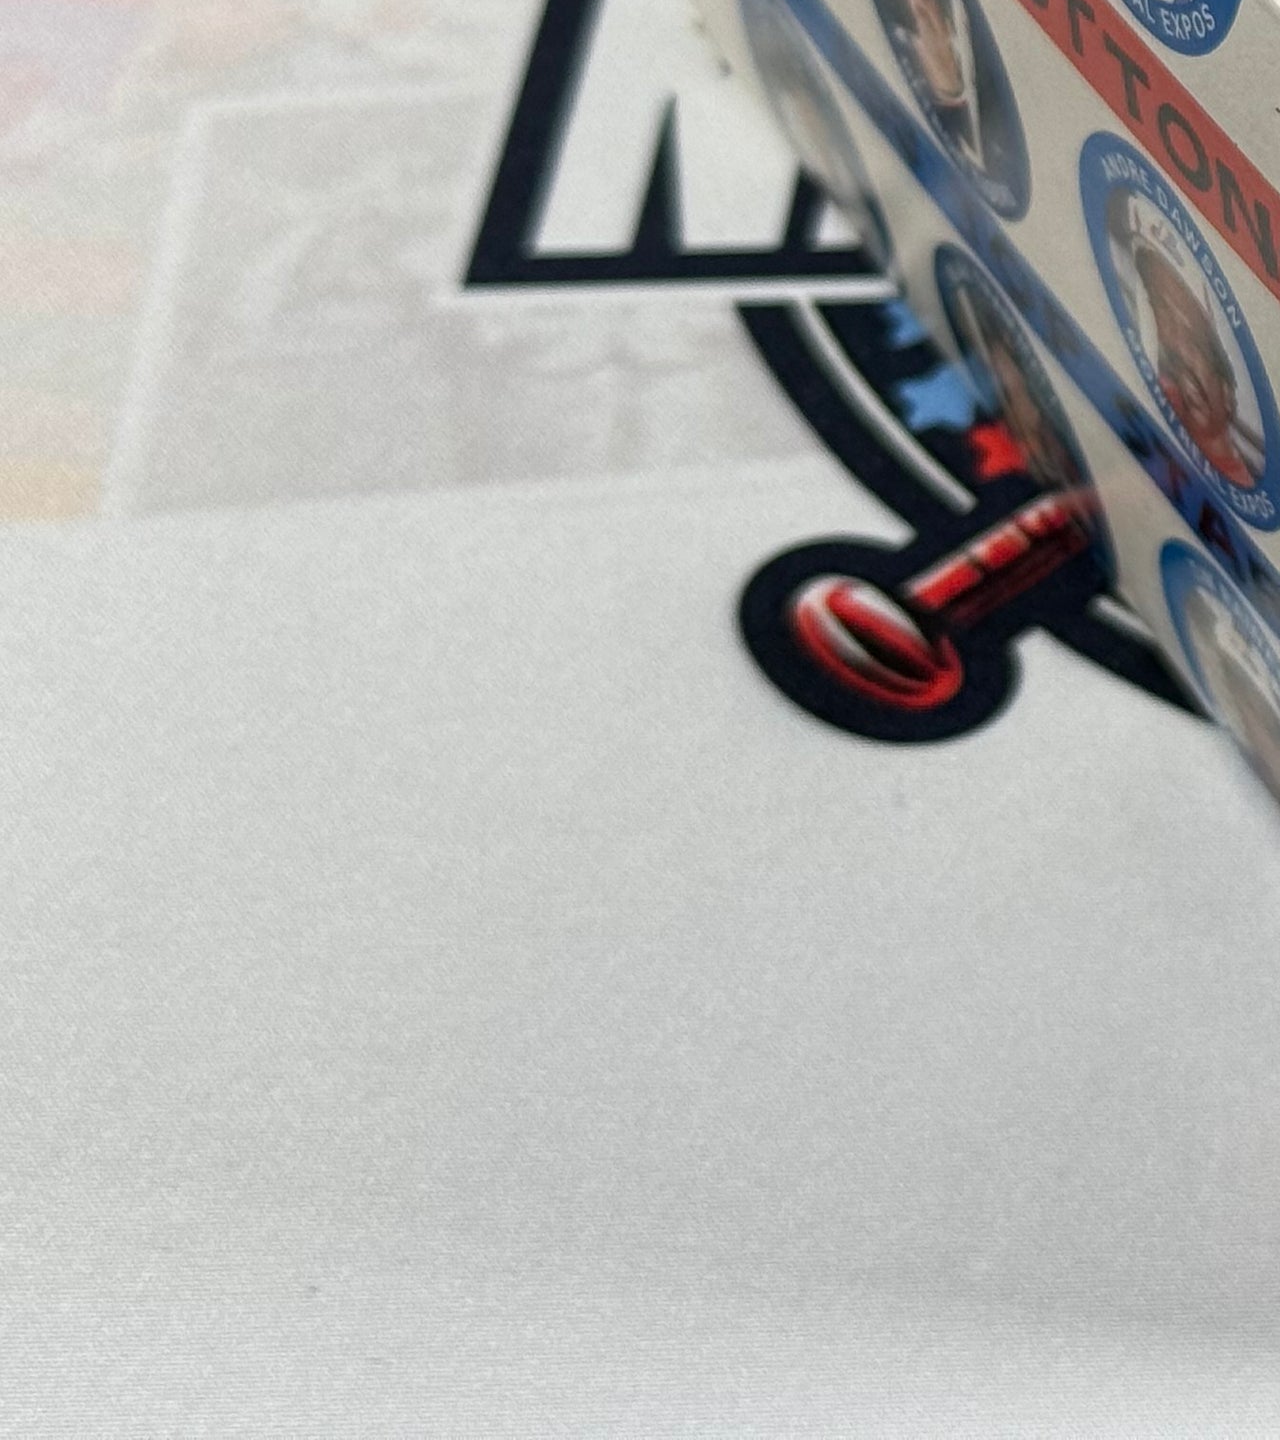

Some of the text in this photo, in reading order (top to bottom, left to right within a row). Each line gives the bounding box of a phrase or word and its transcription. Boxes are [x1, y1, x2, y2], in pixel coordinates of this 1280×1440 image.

[1160, 2, 1216, 41] EXPOS
[1101, 154, 1242, 328] ANDRE DAWSON
[1229, 490, 1277, 520] EXPOS
